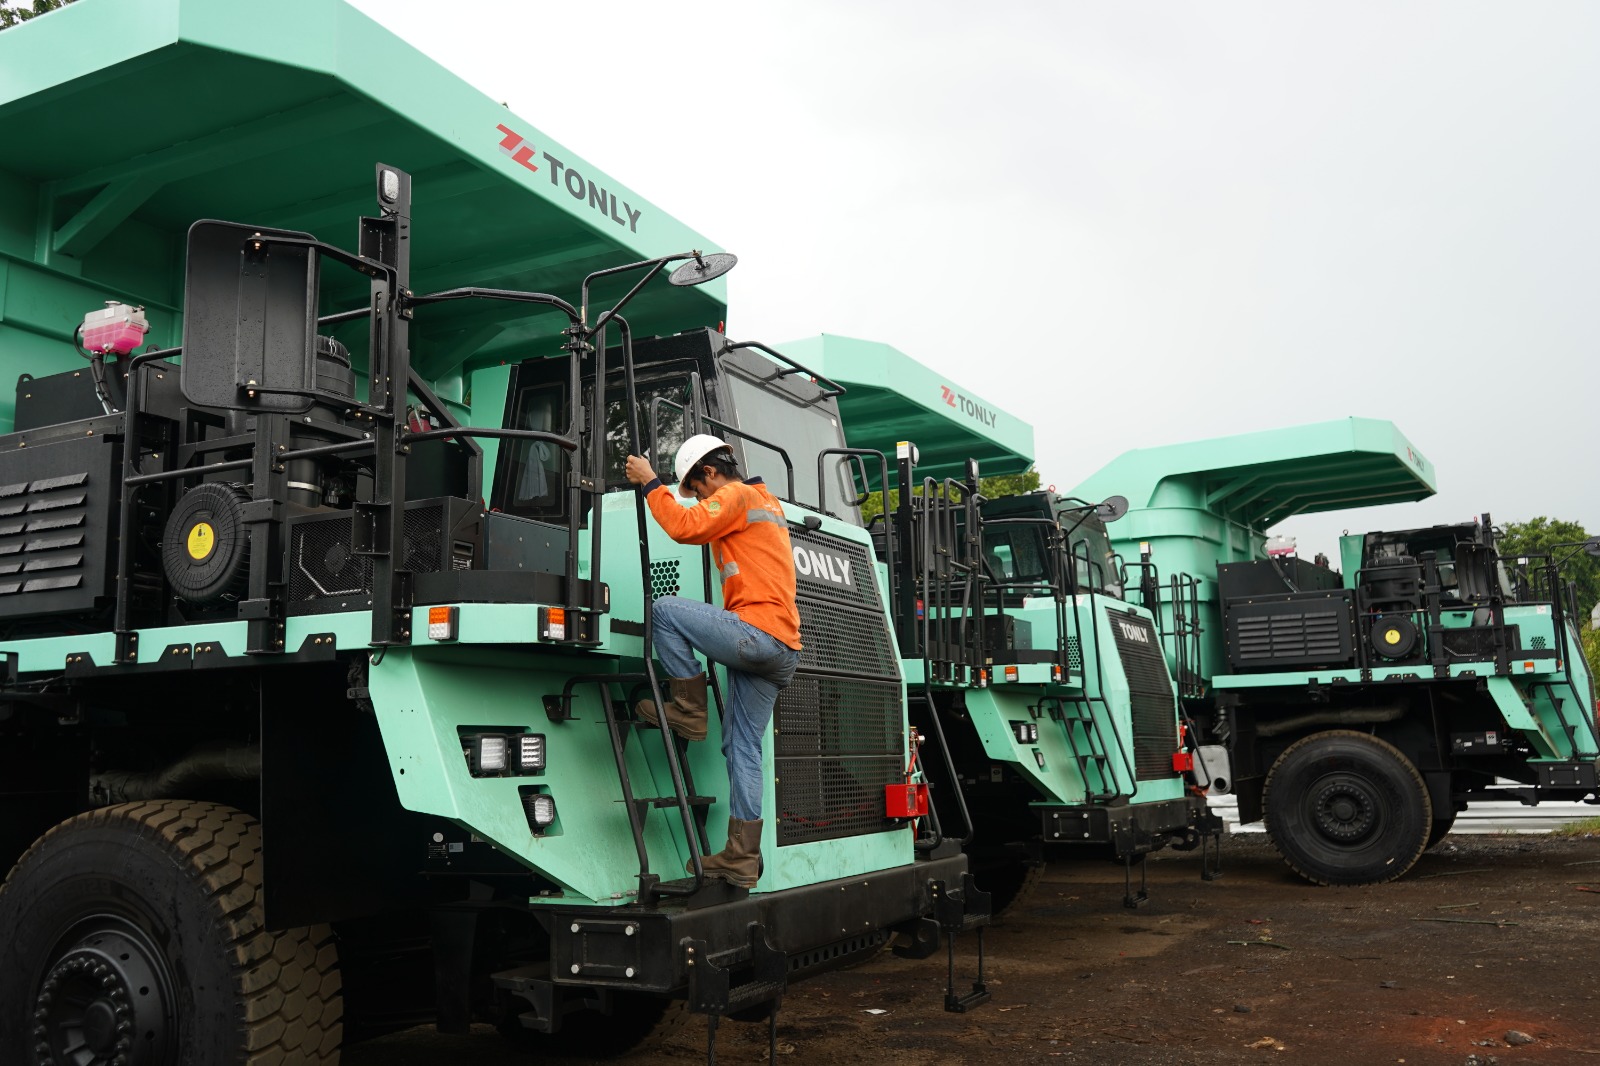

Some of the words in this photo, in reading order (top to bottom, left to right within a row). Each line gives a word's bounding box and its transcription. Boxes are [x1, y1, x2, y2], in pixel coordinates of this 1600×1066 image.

[543, 151, 642, 234] TONLY
[957, 393, 997, 429] TONLY
[792, 546, 851, 586] ONLY
[1119, 622, 1149, 644] TONLY
